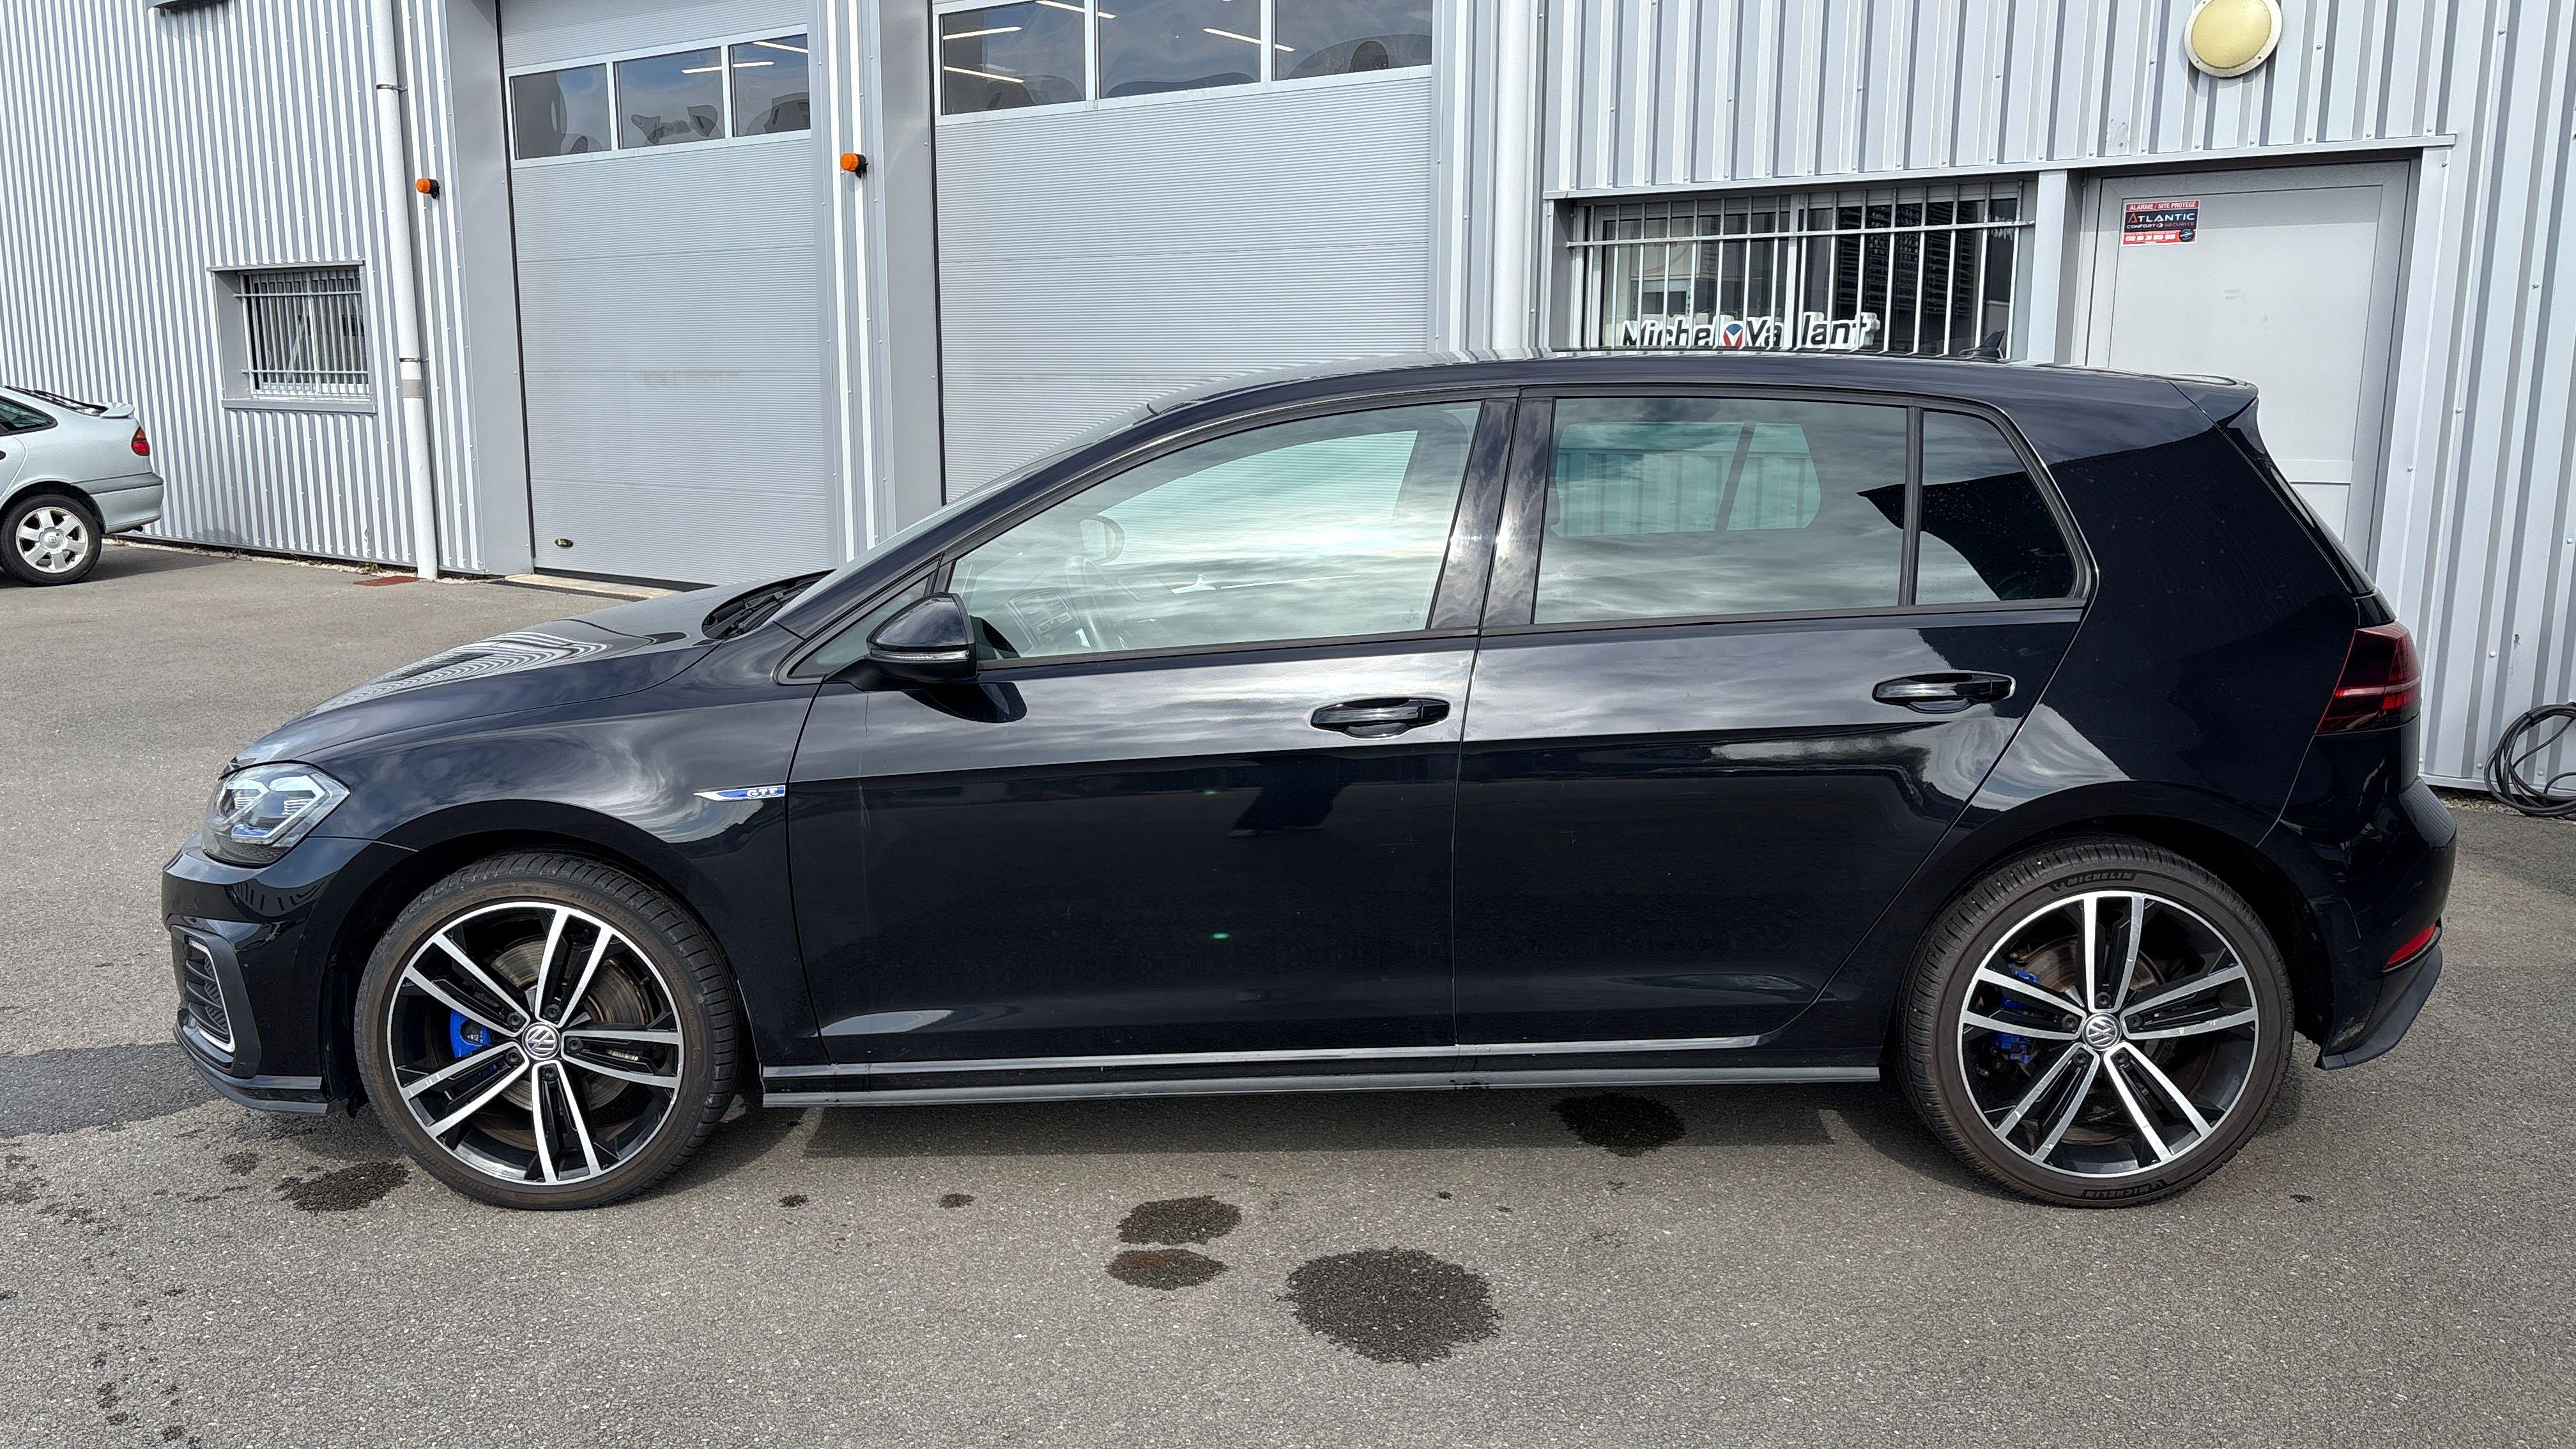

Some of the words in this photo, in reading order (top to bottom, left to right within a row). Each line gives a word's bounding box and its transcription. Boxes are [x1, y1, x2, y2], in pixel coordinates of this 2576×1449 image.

[2128, 212, 2195, 224] ATLANTIC
[1623, 319, 1720, 346] Miche
[1746, 314, 1867, 347] Valant
[2067, 872, 2133, 886] MICHELIN
[2085, 1184, 2149, 1198] MICHELIN
